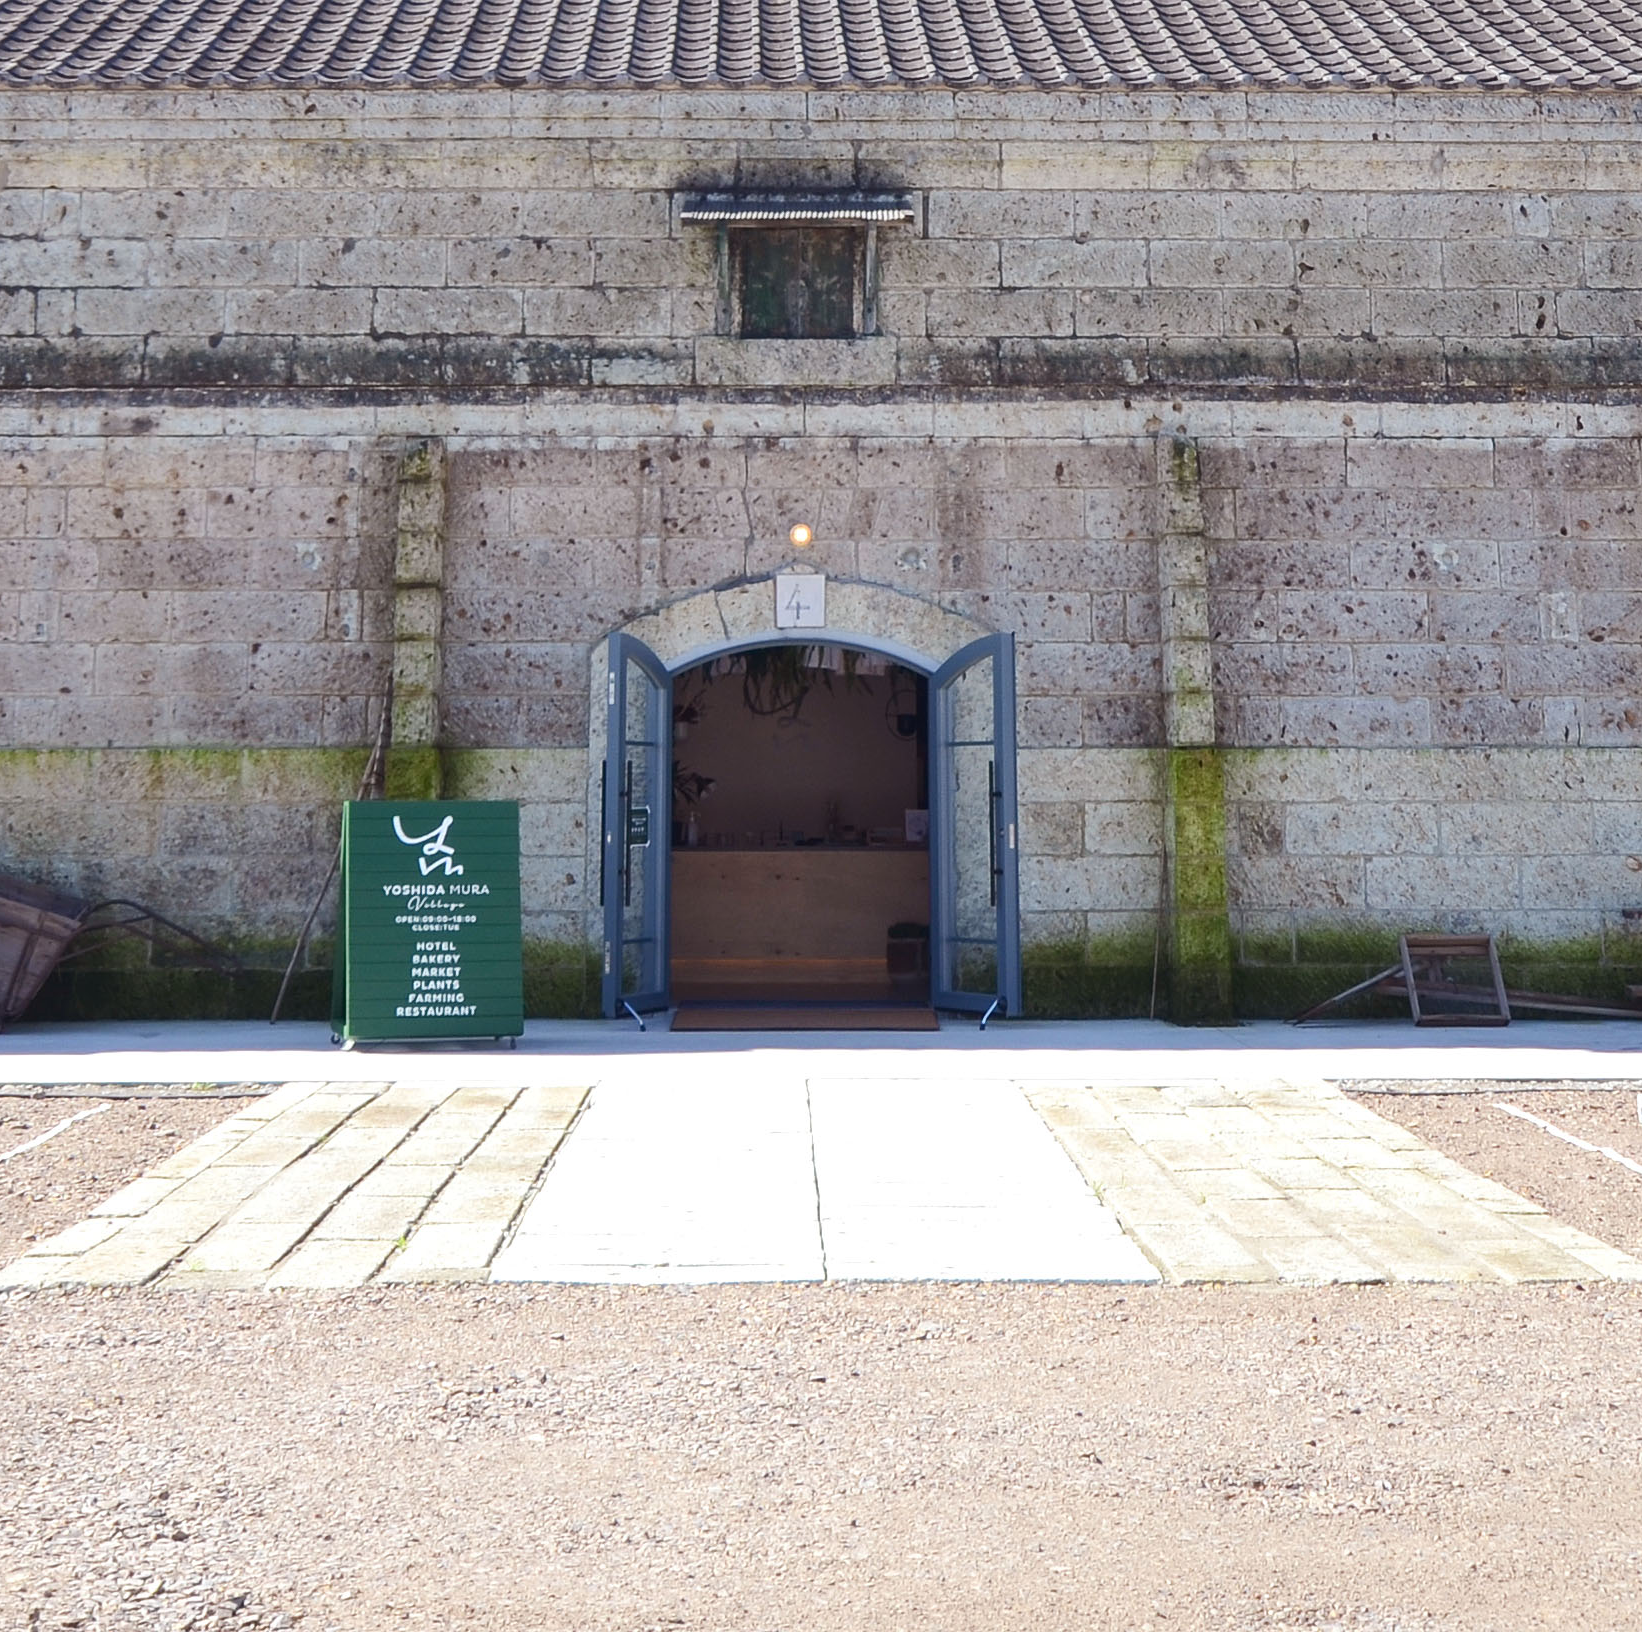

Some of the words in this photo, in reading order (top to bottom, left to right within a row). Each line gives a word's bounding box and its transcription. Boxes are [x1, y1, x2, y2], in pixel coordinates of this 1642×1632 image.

[785, 584, 811, 620] 4
[383, 884, 445, 896] YOSHIDA
[449, 884, 490, 895] MURA
[407, 895, 465, 911] Village
[416, 941, 457, 951] HOTEL
[412, 954, 461, 964] BAKERY
[411, 967, 461, 977] MARKET
[413, 980, 460, 990] PLANTS
[408, 993, 465, 1003] FARMING
[396, 1006, 477, 1017] RESTAURANT
